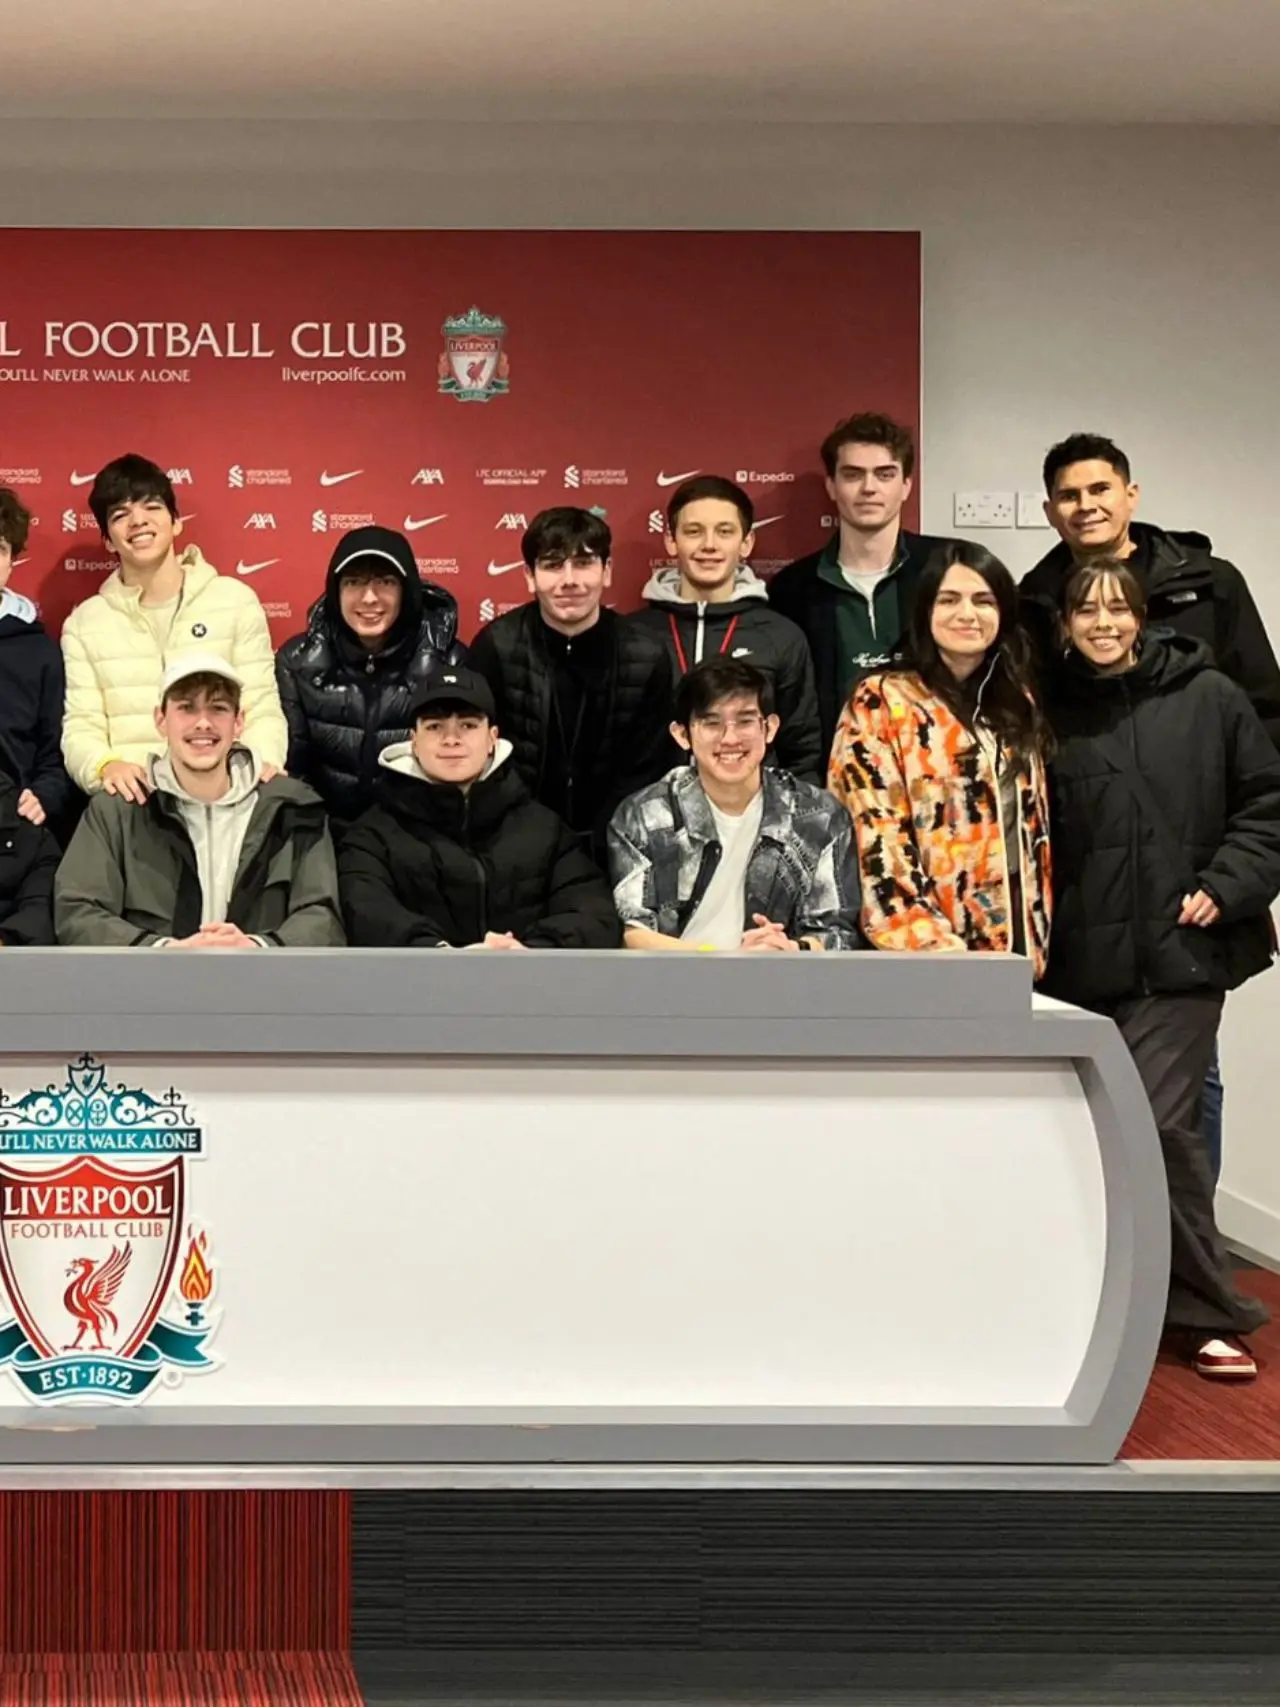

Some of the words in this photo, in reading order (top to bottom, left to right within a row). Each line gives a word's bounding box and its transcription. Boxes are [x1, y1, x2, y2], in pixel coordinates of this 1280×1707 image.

[44, 320, 274, 358] FOOTBALL
[290, 321, 406, 359] CLUB
[43, 368, 89, 383] NEVER
[93, 368, 135, 383] WALK
[139, 368, 191, 383] ALONE
[281, 366, 406, 385] liverpoolfc.com
[246, 469, 289, 477] standard
[246, 476, 292, 485] chartered
[410, 468, 445, 485] AXA
[749, 471, 795, 483] Expedia
[243, 512, 277, 529] AXA
[494, 513, 529, 530] AXA
[33, 1132, 87, 1149] NEVER
[88, 1132, 140, 1149] WALK
[141, 1131, 198, 1149] ALONE
[4, 1185, 171, 1216] LIVERPOOL
[10, 1223, 108, 1239] FOOTBALL
[115, 1222, 164, 1238] CLUB
